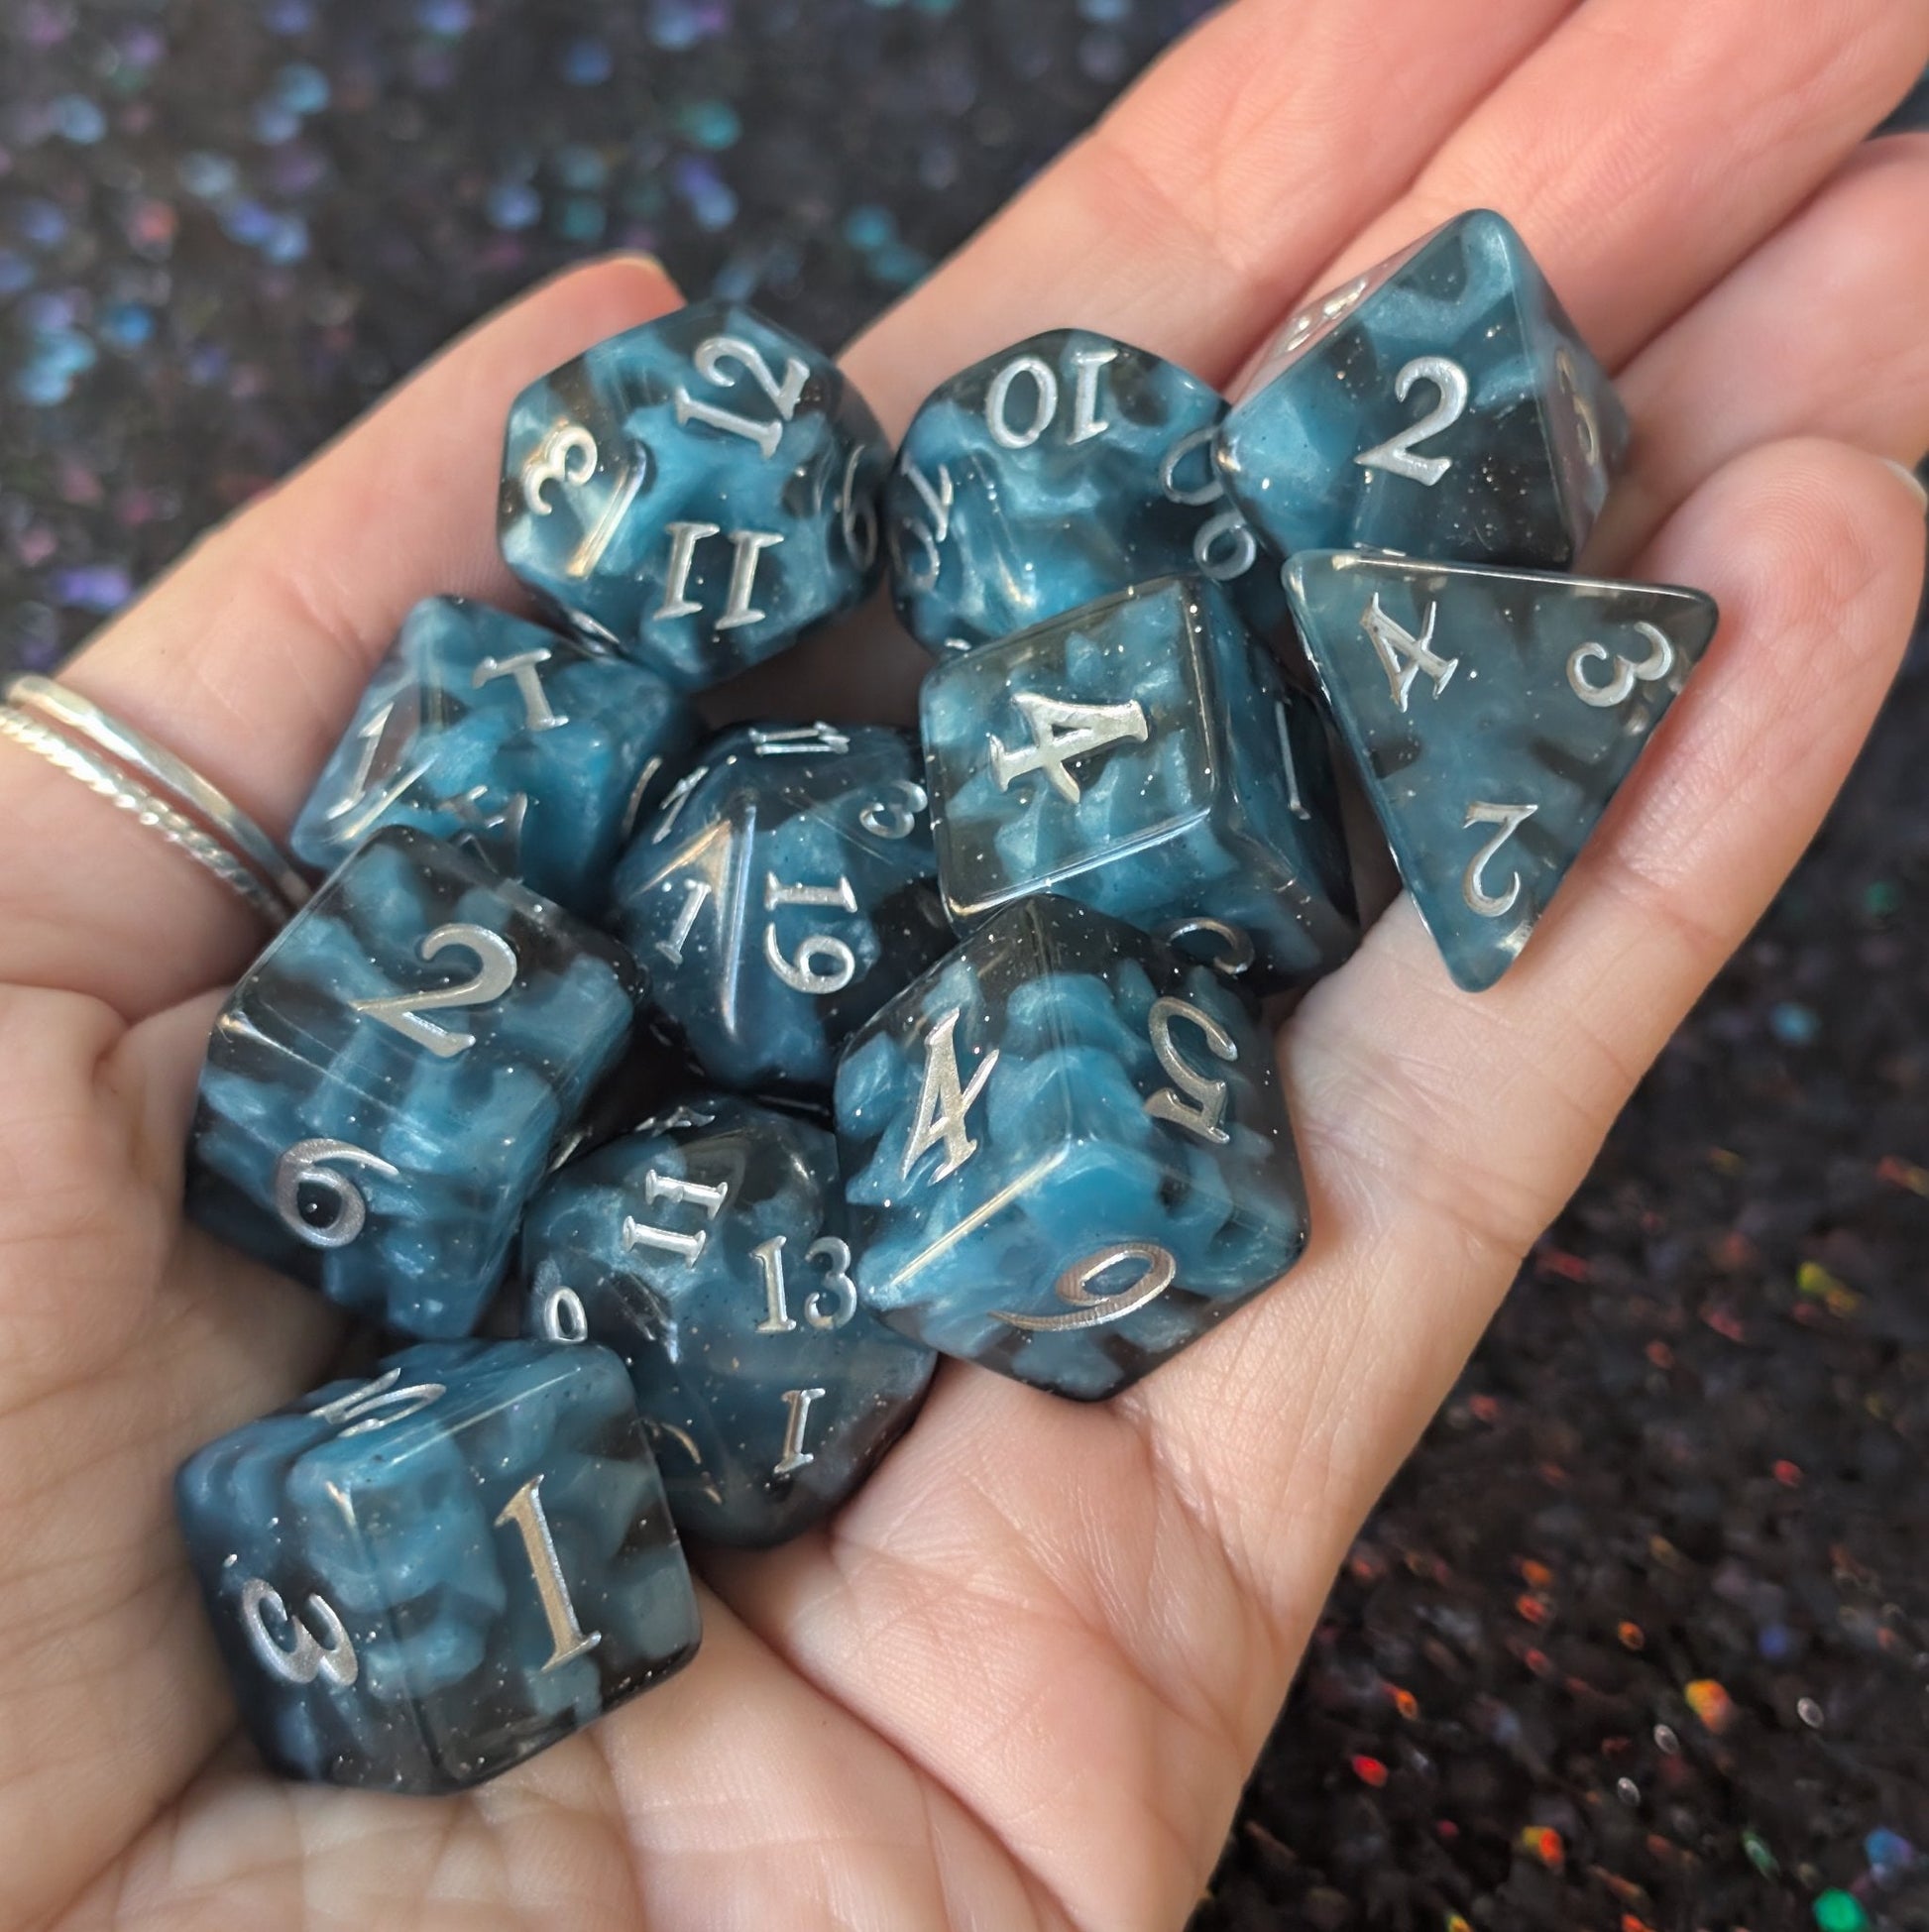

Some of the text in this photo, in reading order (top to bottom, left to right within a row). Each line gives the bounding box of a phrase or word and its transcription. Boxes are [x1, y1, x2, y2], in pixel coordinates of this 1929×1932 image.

[675, 337, 810, 461] 12
[985, 349, 1118, 449] 10
[1354, 356, 1468, 487] 2
[521, 416, 598, 515] 3
[653, 521, 785, 630] 11
[1359, 592, 1459, 713] 4
[1566, 622, 1675, 707] 3
[990, 693, 1150, 804] 4
[1463, 801, 1538, 917] 2
[763, 869, 858, 994] 19
[347, 923, 518, 1059] 2
[903, 1007, 1000, 1187] 4
[1145, 995, 1238, 1144] 5
[276, 1138, 401, 1249] 6
[623, 1169, 729, 1270] 11
[749, 1235, 858, 1334] 13
[496, 1474, 602, 1672] 1
[242, 1578, 358, 1686] 3
